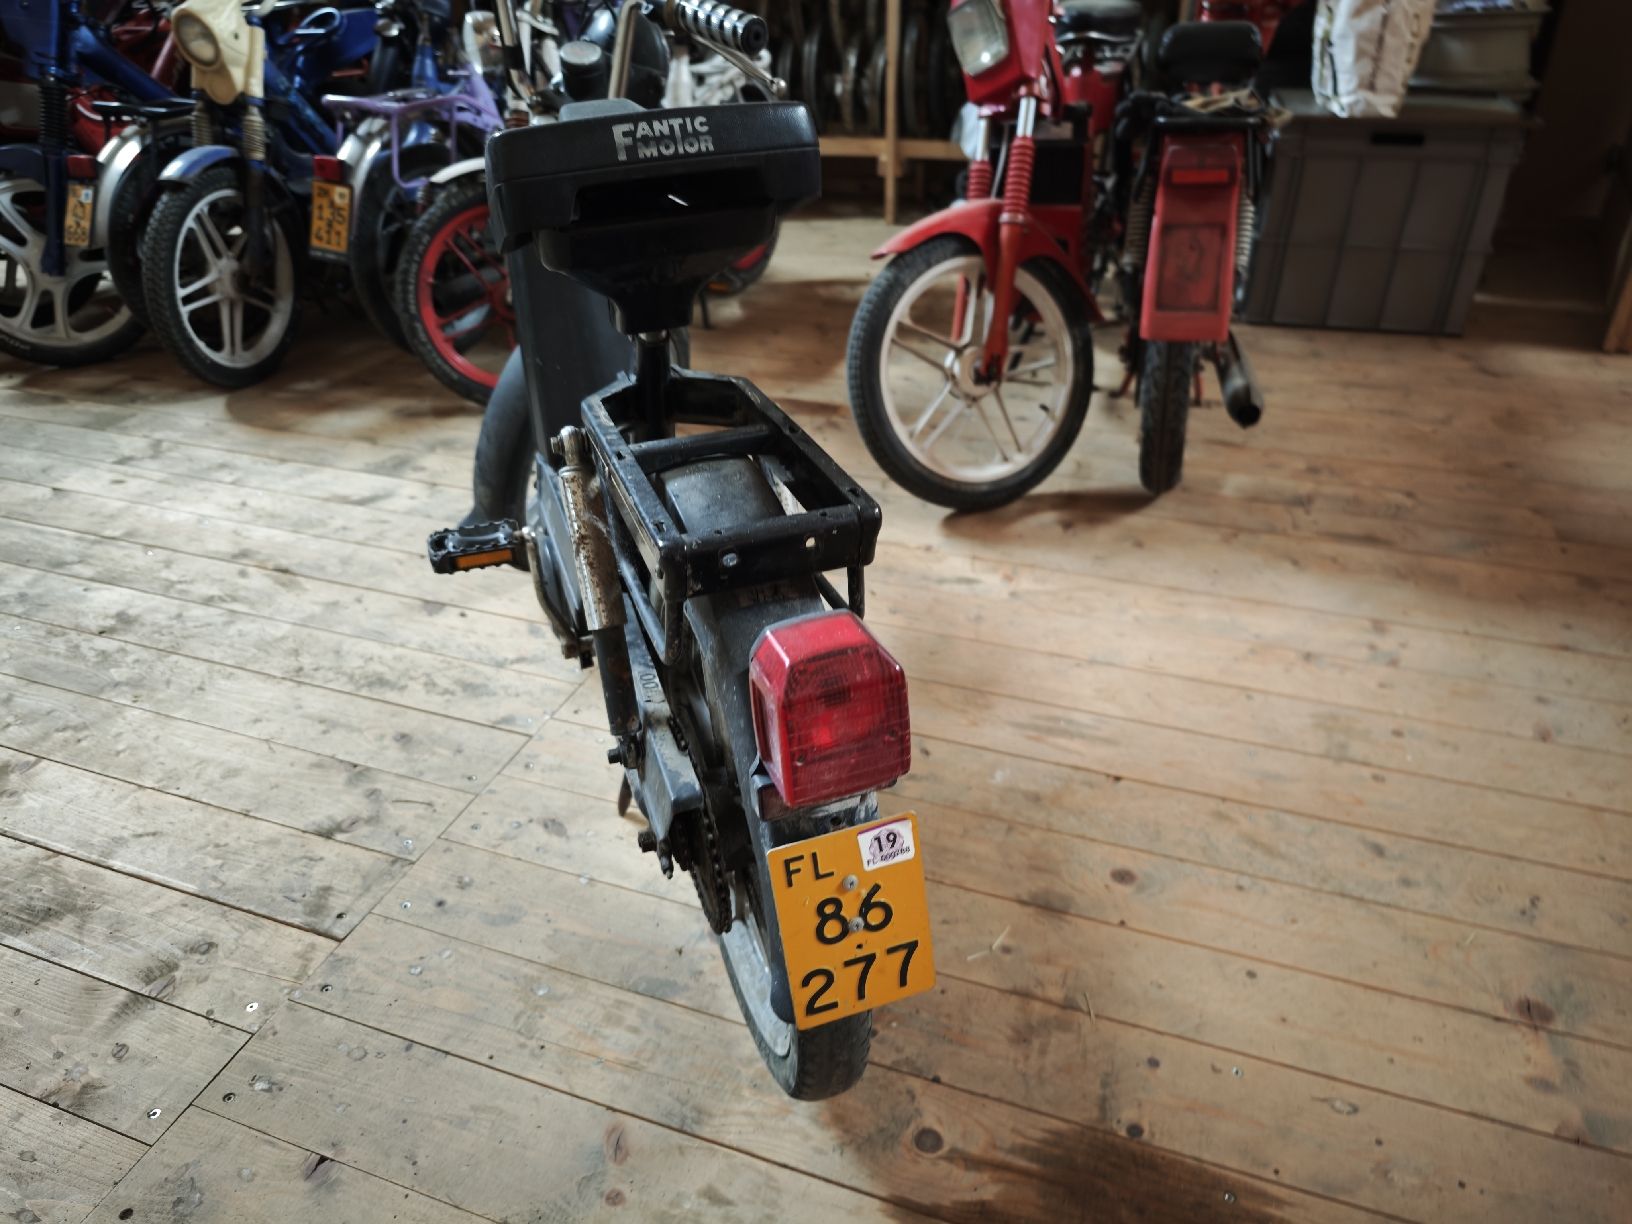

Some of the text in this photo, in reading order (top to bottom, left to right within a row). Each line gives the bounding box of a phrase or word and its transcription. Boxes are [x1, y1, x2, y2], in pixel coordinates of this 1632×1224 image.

[612, 115, 710, 161] FANTIC
[637, 134, 715, 159] MOTOR
[874, 831, 898, 853] 19
[783, 851, 835, 888] FL
[815, 882, 894, 946] 86
[801, 939, 919, 1017] 277
